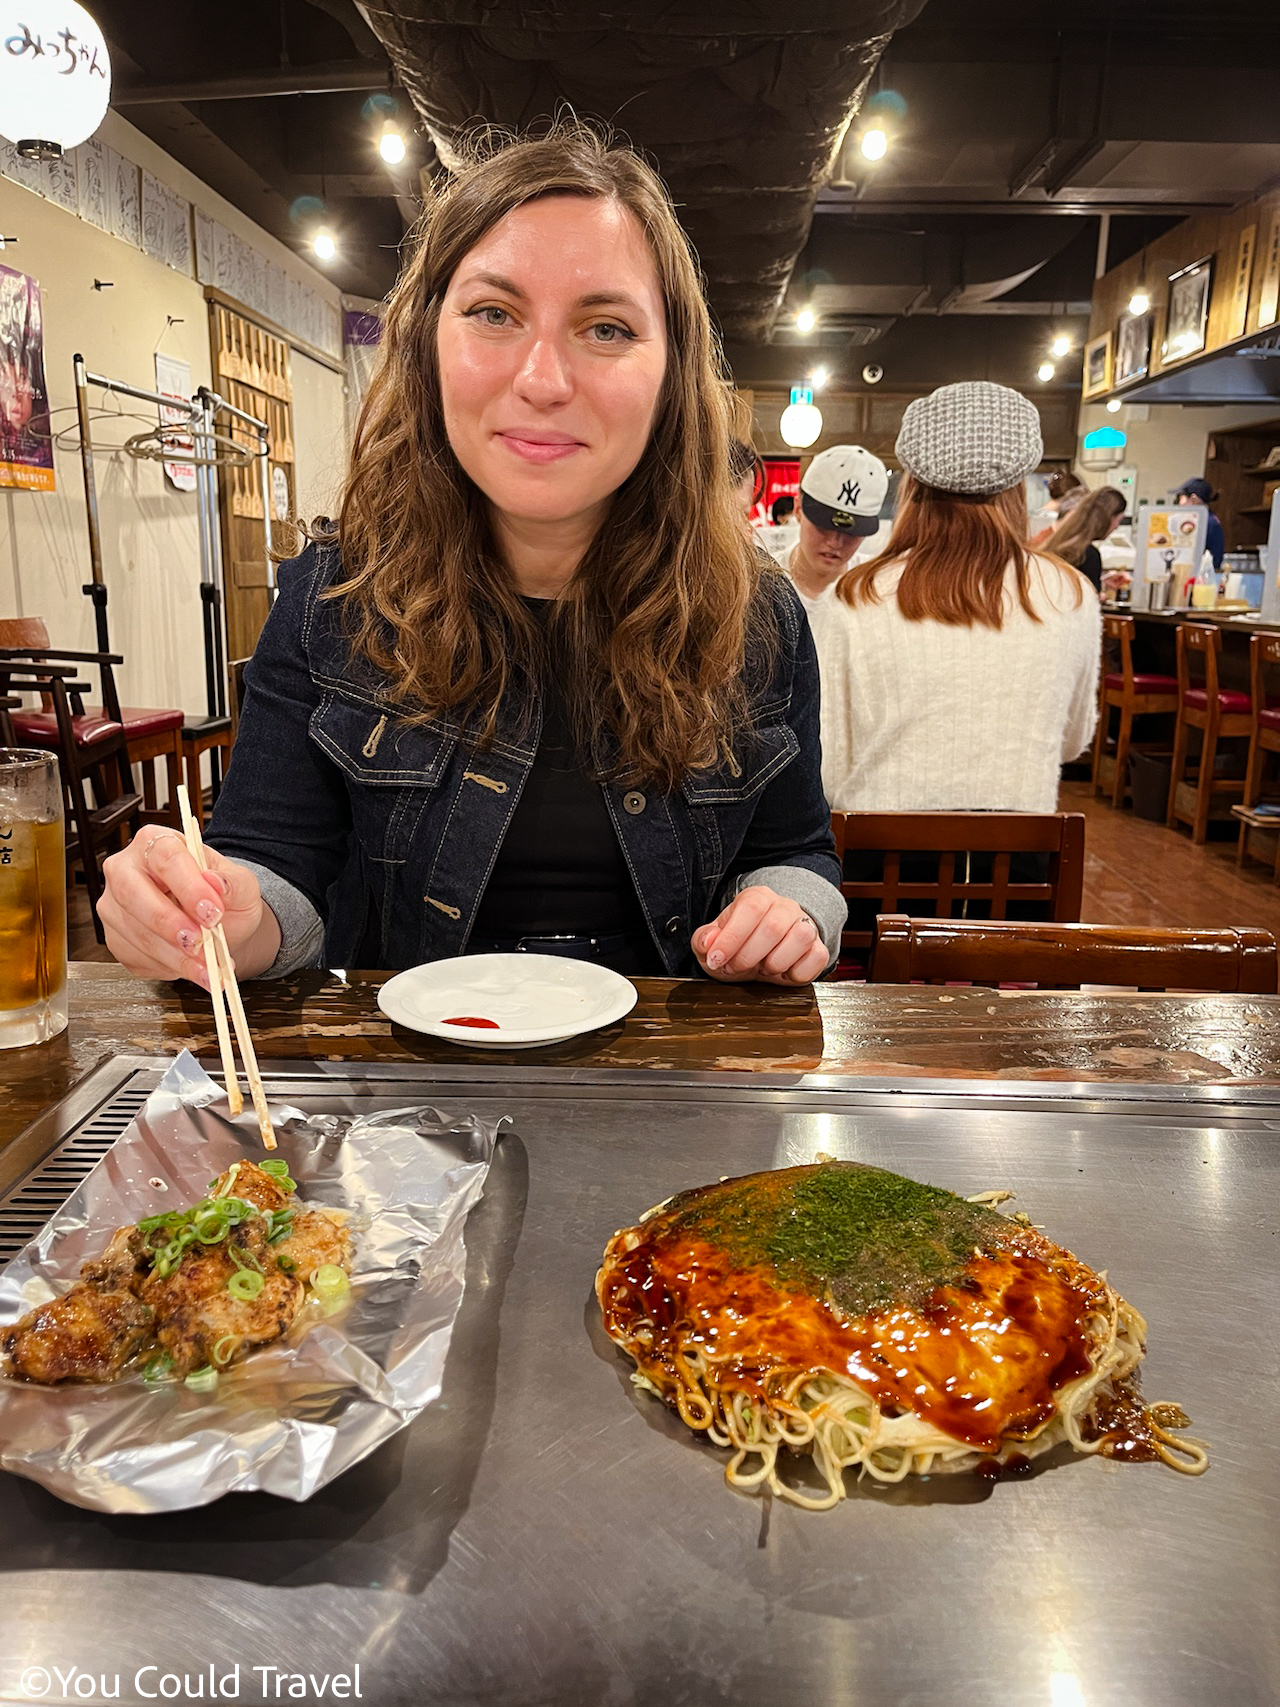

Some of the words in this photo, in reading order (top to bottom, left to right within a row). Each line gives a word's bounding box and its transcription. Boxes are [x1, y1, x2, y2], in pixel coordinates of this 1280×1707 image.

[5, 22, 106, 79] みっちゃん
[837, 479, 861, 506] NY
